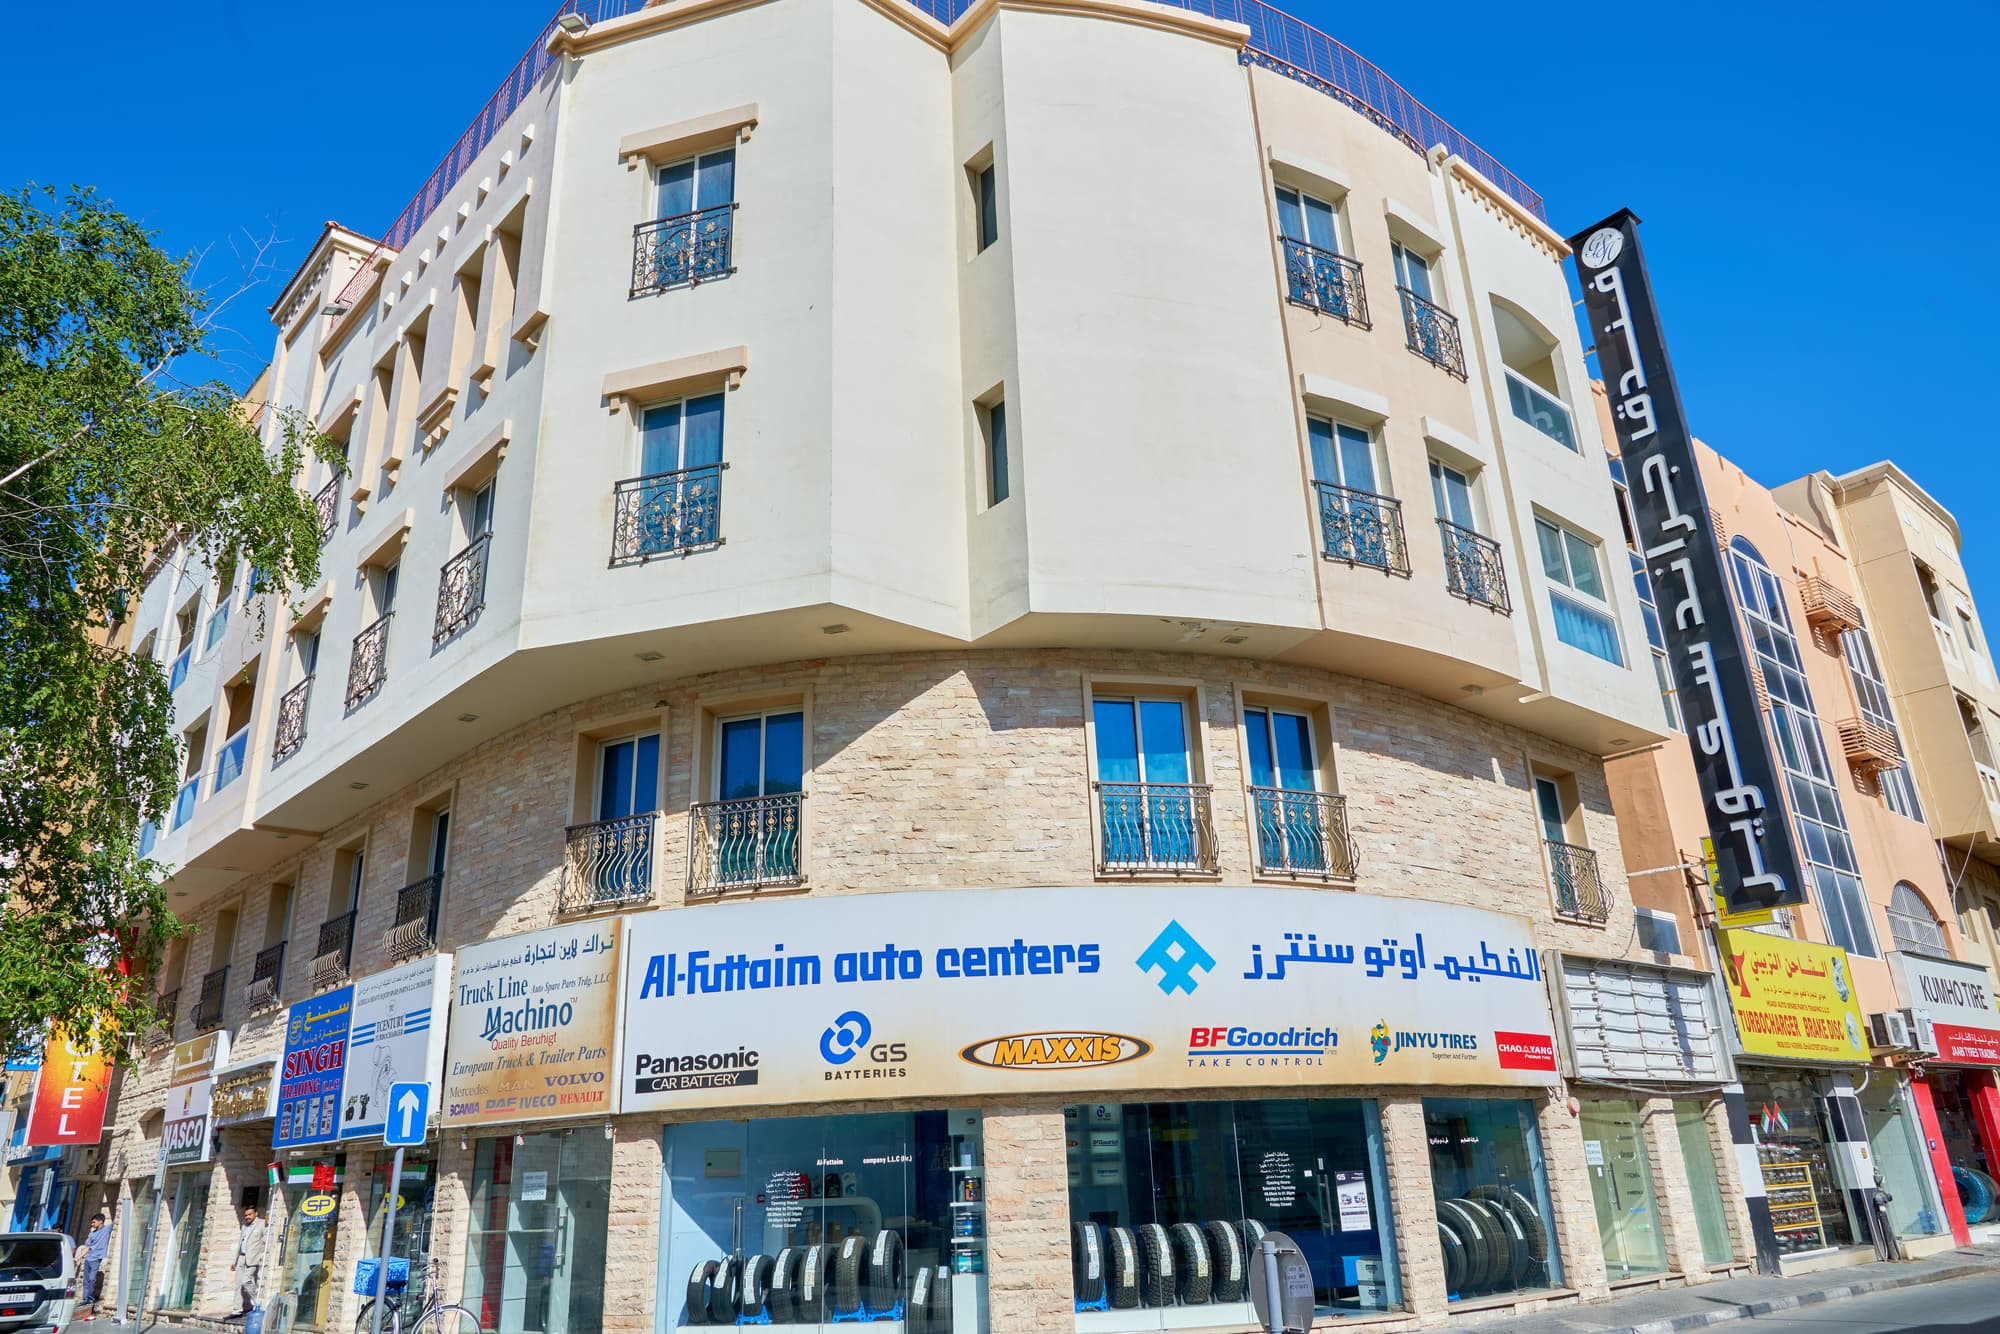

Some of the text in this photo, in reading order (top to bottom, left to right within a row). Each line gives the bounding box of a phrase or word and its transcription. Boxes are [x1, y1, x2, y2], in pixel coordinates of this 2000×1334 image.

[1588, 266, 1657, 442] فندق
[1642, 453, 1705, 631] جراند
[1688, 641, 1786, 891] سكوير
[524, 941, 556, 965] لتجارة
[559, 939, 578, 960] لاين
[582, 933, 614, 954] تراك
[640, 939, 1100, 999] Al-Futtaim auto centers
[1243, 932, 1542, 982] الفطيم اوتو سنترز
[460, 979, 494, 1006] Truck
[499, 976, 528, 1000] Line
[544, 981, 561, 994] Spare
[562, 978, 577, 988] Parts
[1919, 975, 1988, 1010] KUMHO TIRE
[480, 998, 573, 1041] Machino
[1738, 1010, 1844, 1040] TURBOCHARGER BRAKE DISC
[491, 1032, 557, 1050] Quality Beruhigt
[1190, 1027, 1338, 1047] BFGoodrich
[1394, 1032, 1477, 1052] JINYU TIRES
[284, 1039, 345, 1080] SINGH
[453, 1046, 606, 1076] European Truck & Trailer Parts
[636, 1046, 759, 1075] Panasonic
[870, 1043, 907, 1062] GS
[993, 1035, 1121, 1065] MAXXIS
[1432, 1052, 1451, 1061] Together
[58, 1008, 101, 1136] OTEL
[825, 1068, 906, 1081] BATTERIES
[1188, 1058, 1323, 1067] TAKE CONTROL
[281, 1078, 320, 1099] TRADING
[450, 1071, 605, 1098] Mercedes MAN VOLVO
[652, 1073, 739, 1090] CAR BATTERY
[485, 1097, 516, 1109] DAF
[519, 1094, 557, 1109] IVECO
[560, 1091, 604, 1105] RENAULT
[163, 1119, 203, 1150] NASCO
[816, 1158, 844, 1166] Al-Futtaim
[862, 1157, 886, 1165] company
[307, 1200, 330, 1212] SP
